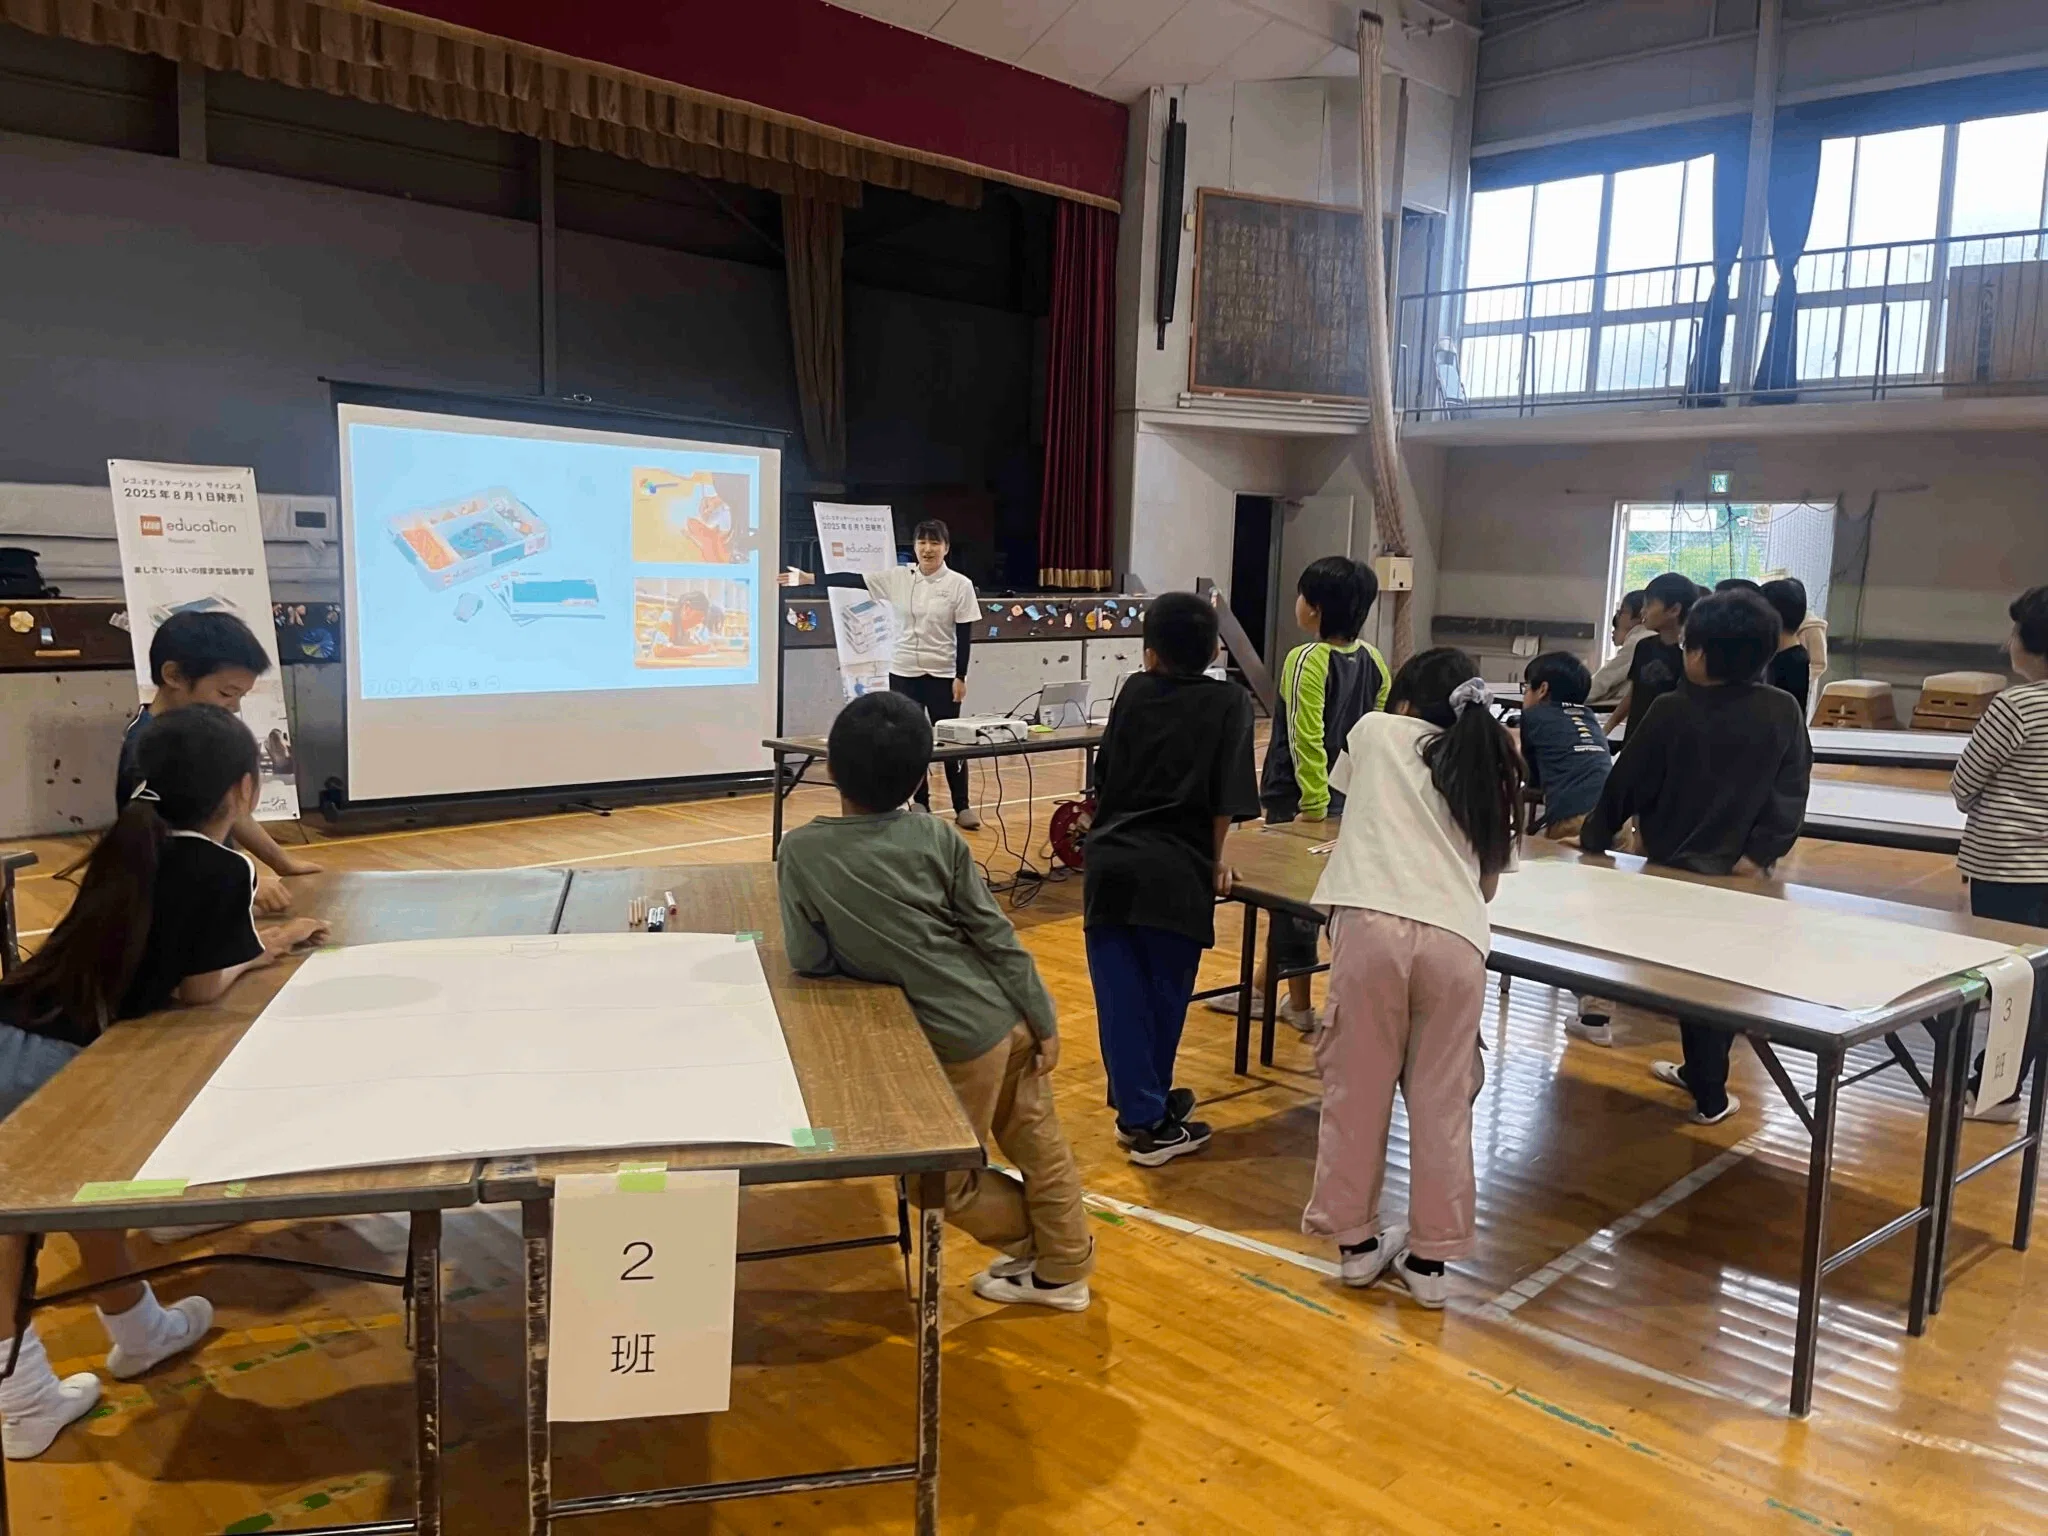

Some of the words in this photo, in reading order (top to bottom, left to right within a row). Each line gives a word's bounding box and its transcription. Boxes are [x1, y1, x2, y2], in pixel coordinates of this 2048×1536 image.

[166, 517, 237, 533] education
[2003, 997, 2013, 1022] 3
[620, 1241, 655, 1281] 2
[610, 1333, 656, 1375] 班
